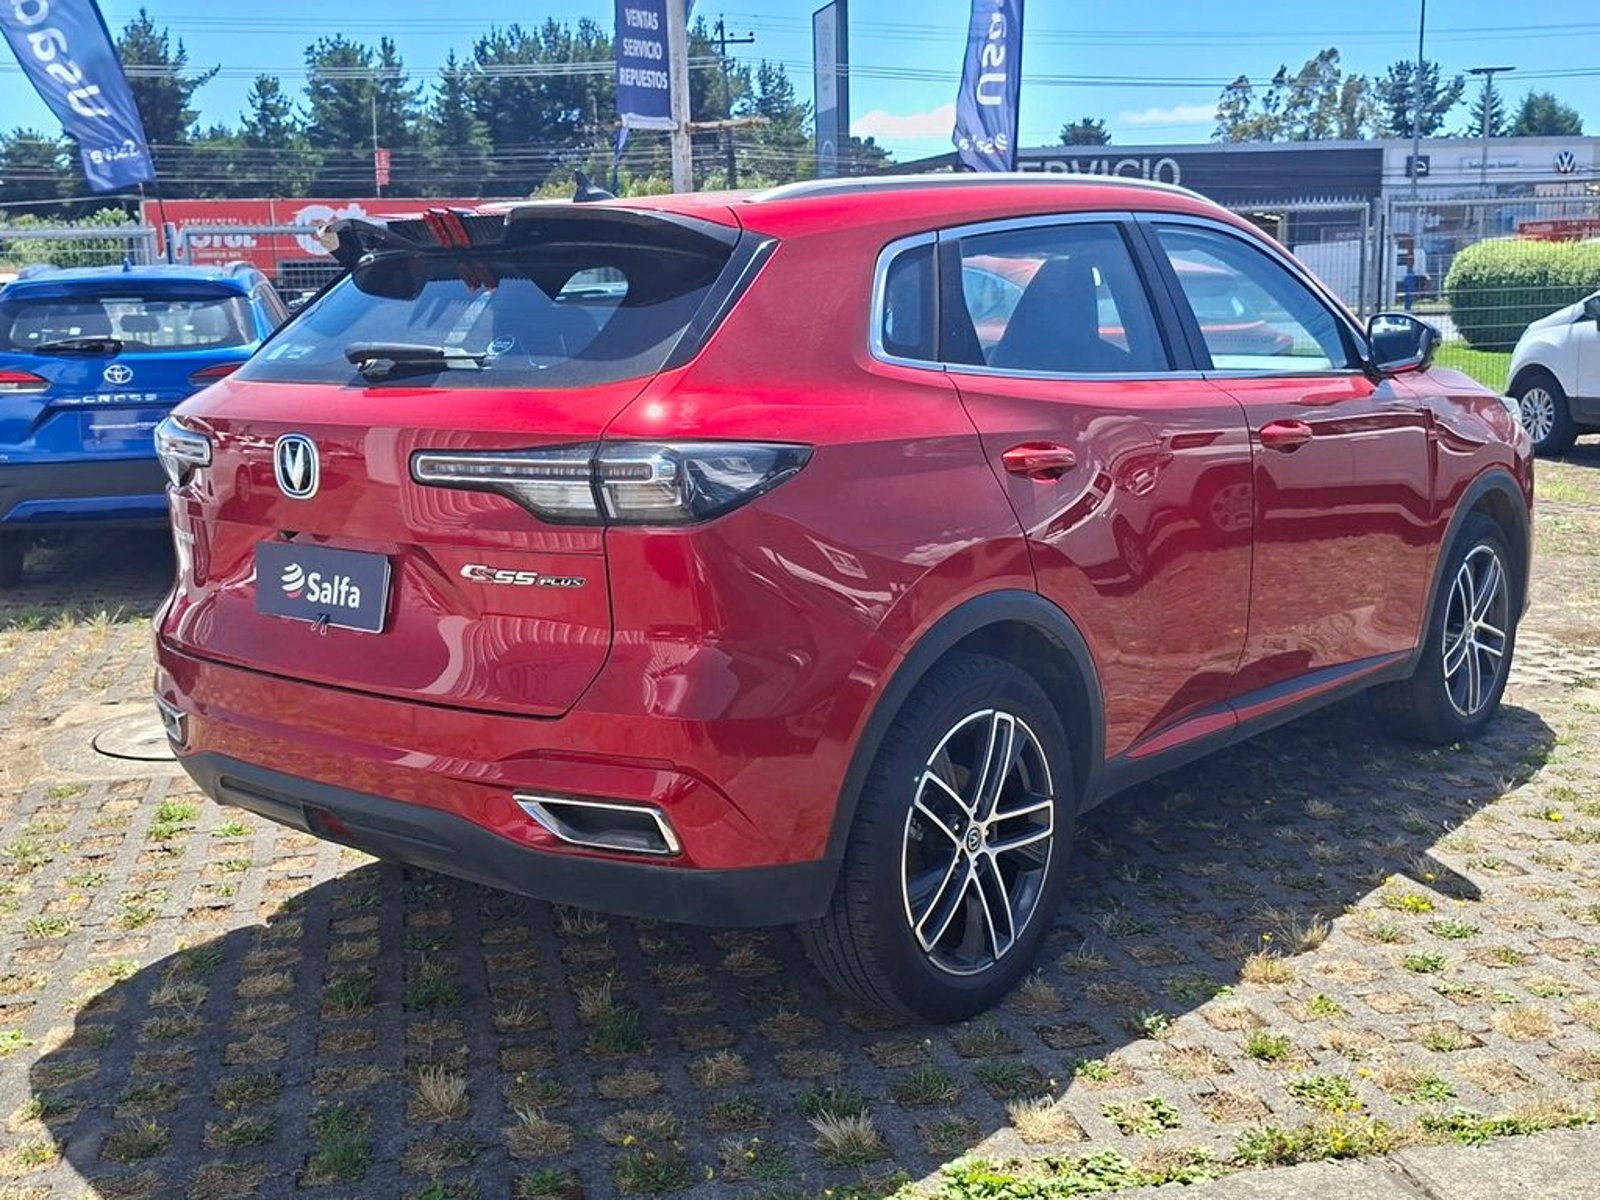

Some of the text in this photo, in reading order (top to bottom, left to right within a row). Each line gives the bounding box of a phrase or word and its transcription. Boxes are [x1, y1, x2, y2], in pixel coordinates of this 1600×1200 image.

[624, 8, 659, 30] VENTAS
[623, 38, 662, 60] SERVICIO
[620, 67, 668, 90] REPUESTOS
[82, 393, 157, 404] CROSS
[306, 572, 360, 609] Salfa
